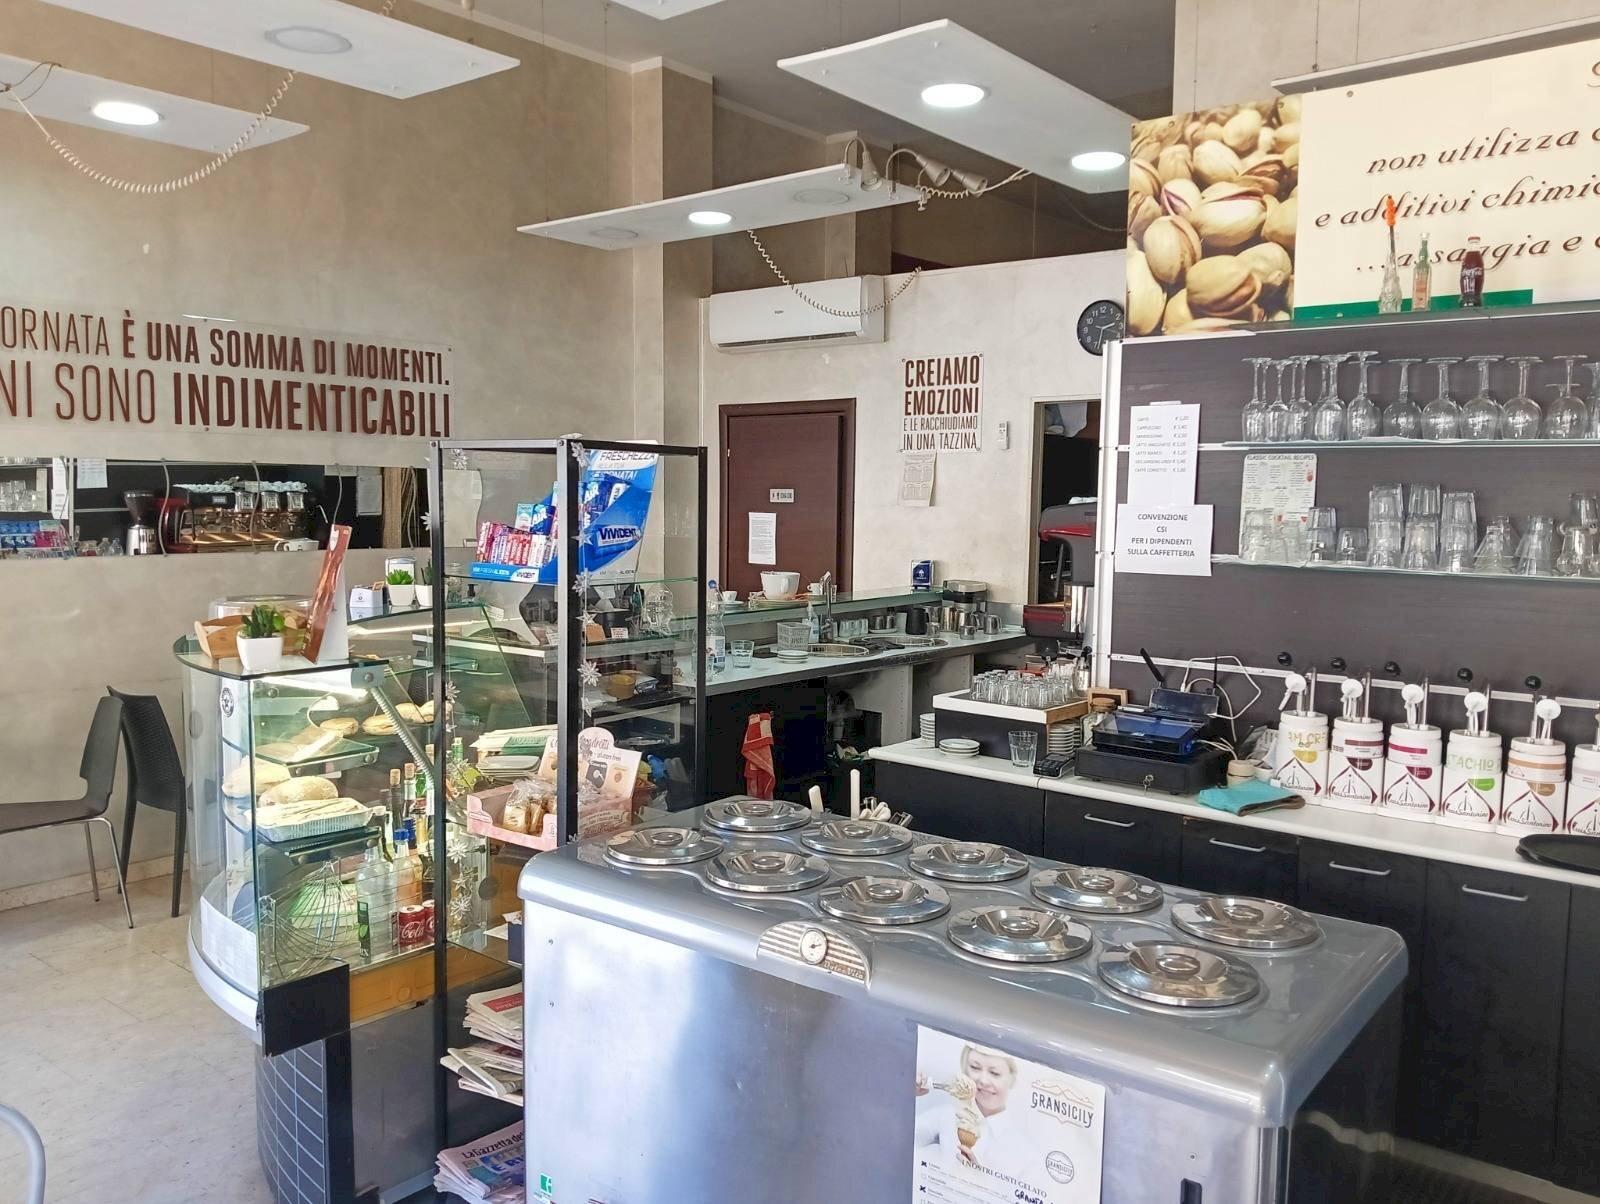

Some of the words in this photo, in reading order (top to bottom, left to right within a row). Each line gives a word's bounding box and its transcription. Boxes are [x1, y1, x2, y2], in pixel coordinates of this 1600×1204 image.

[1366, 152, 1426, 174] non
[1438, 127, 1579, 164] utilizza
[1314, 213, 1331, 228] e
[1563, 236, 1582, 252] e
[1, 306, 110, 356] ORNATA
[122, 310, 136, 358] È
[146, 321, 200, 364] UNA
[210, 328, 304, 373] SOMMA
[313, 339, 336, 375] DI
[346, 342, 450, 386] MOMENTI.
[905, 355, 980, 388] CREIAMO
[55, 362, 156, 424] SONO
[173, 372, 450, 438] INDIMENTICABILI
[904, 387, 979, 416] EMOZIONI
[903, 417, 908, 431] E
[910, 417, 918, 431] LE
[920, 415, 978, 431] RACCHIUDIAMO
[903, 434, 913, 450] IN
[916, 434, 935, 450] UNA
[939, 432, 977, 450] TAZZINA
[1149, 549, 1195, 557] CAFFETTERIA
[1031, 1091, 1093, 1128] GRANSICILY
[966, 1160, 994, 1176] NOSTRI
[994, 1171, 1018, 1186] GUSTI
[1018, 1180, 1047, 1199] GELATO
